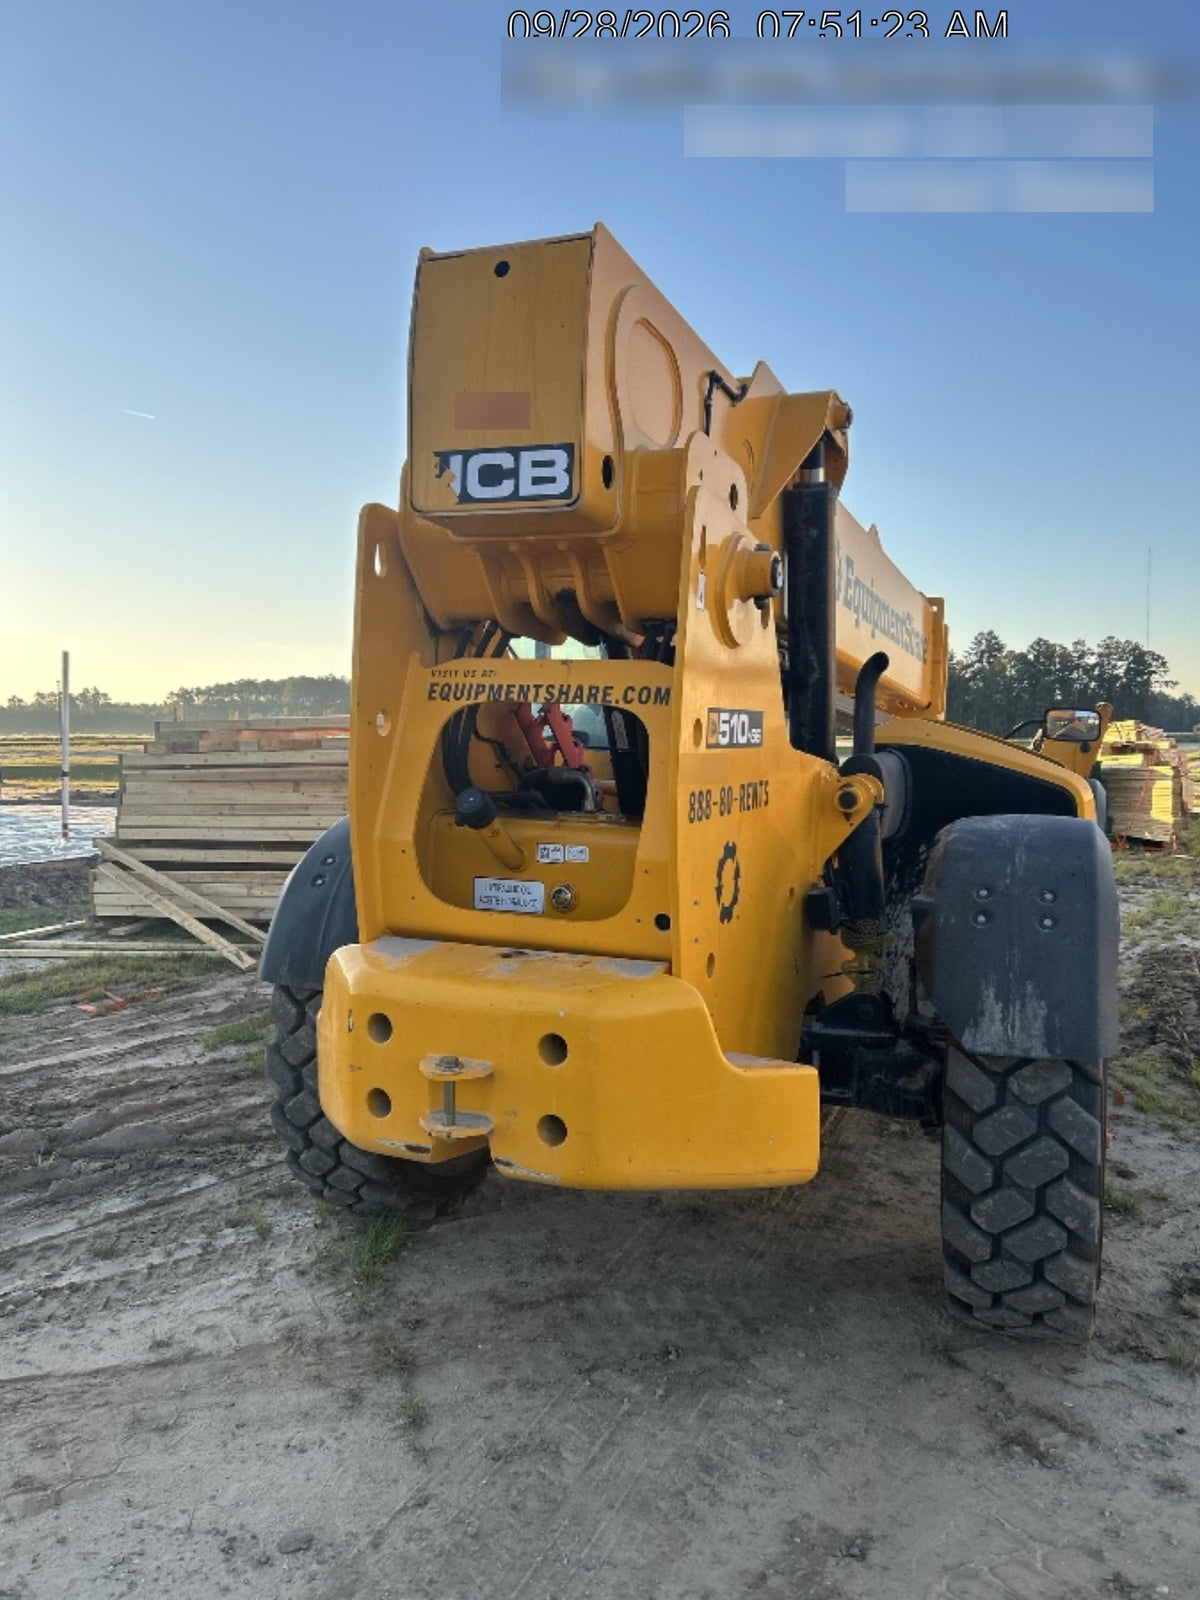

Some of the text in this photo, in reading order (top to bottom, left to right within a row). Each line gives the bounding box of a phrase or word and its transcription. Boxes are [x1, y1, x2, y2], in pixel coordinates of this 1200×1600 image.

[430, 669, 459, 679] VISIT
[463, 669, 477, 679] US
[427, 682, 672, 706] EQUIPMENTSHARE.COM
[688, 779, 769, 824] 888-80-RENTS
